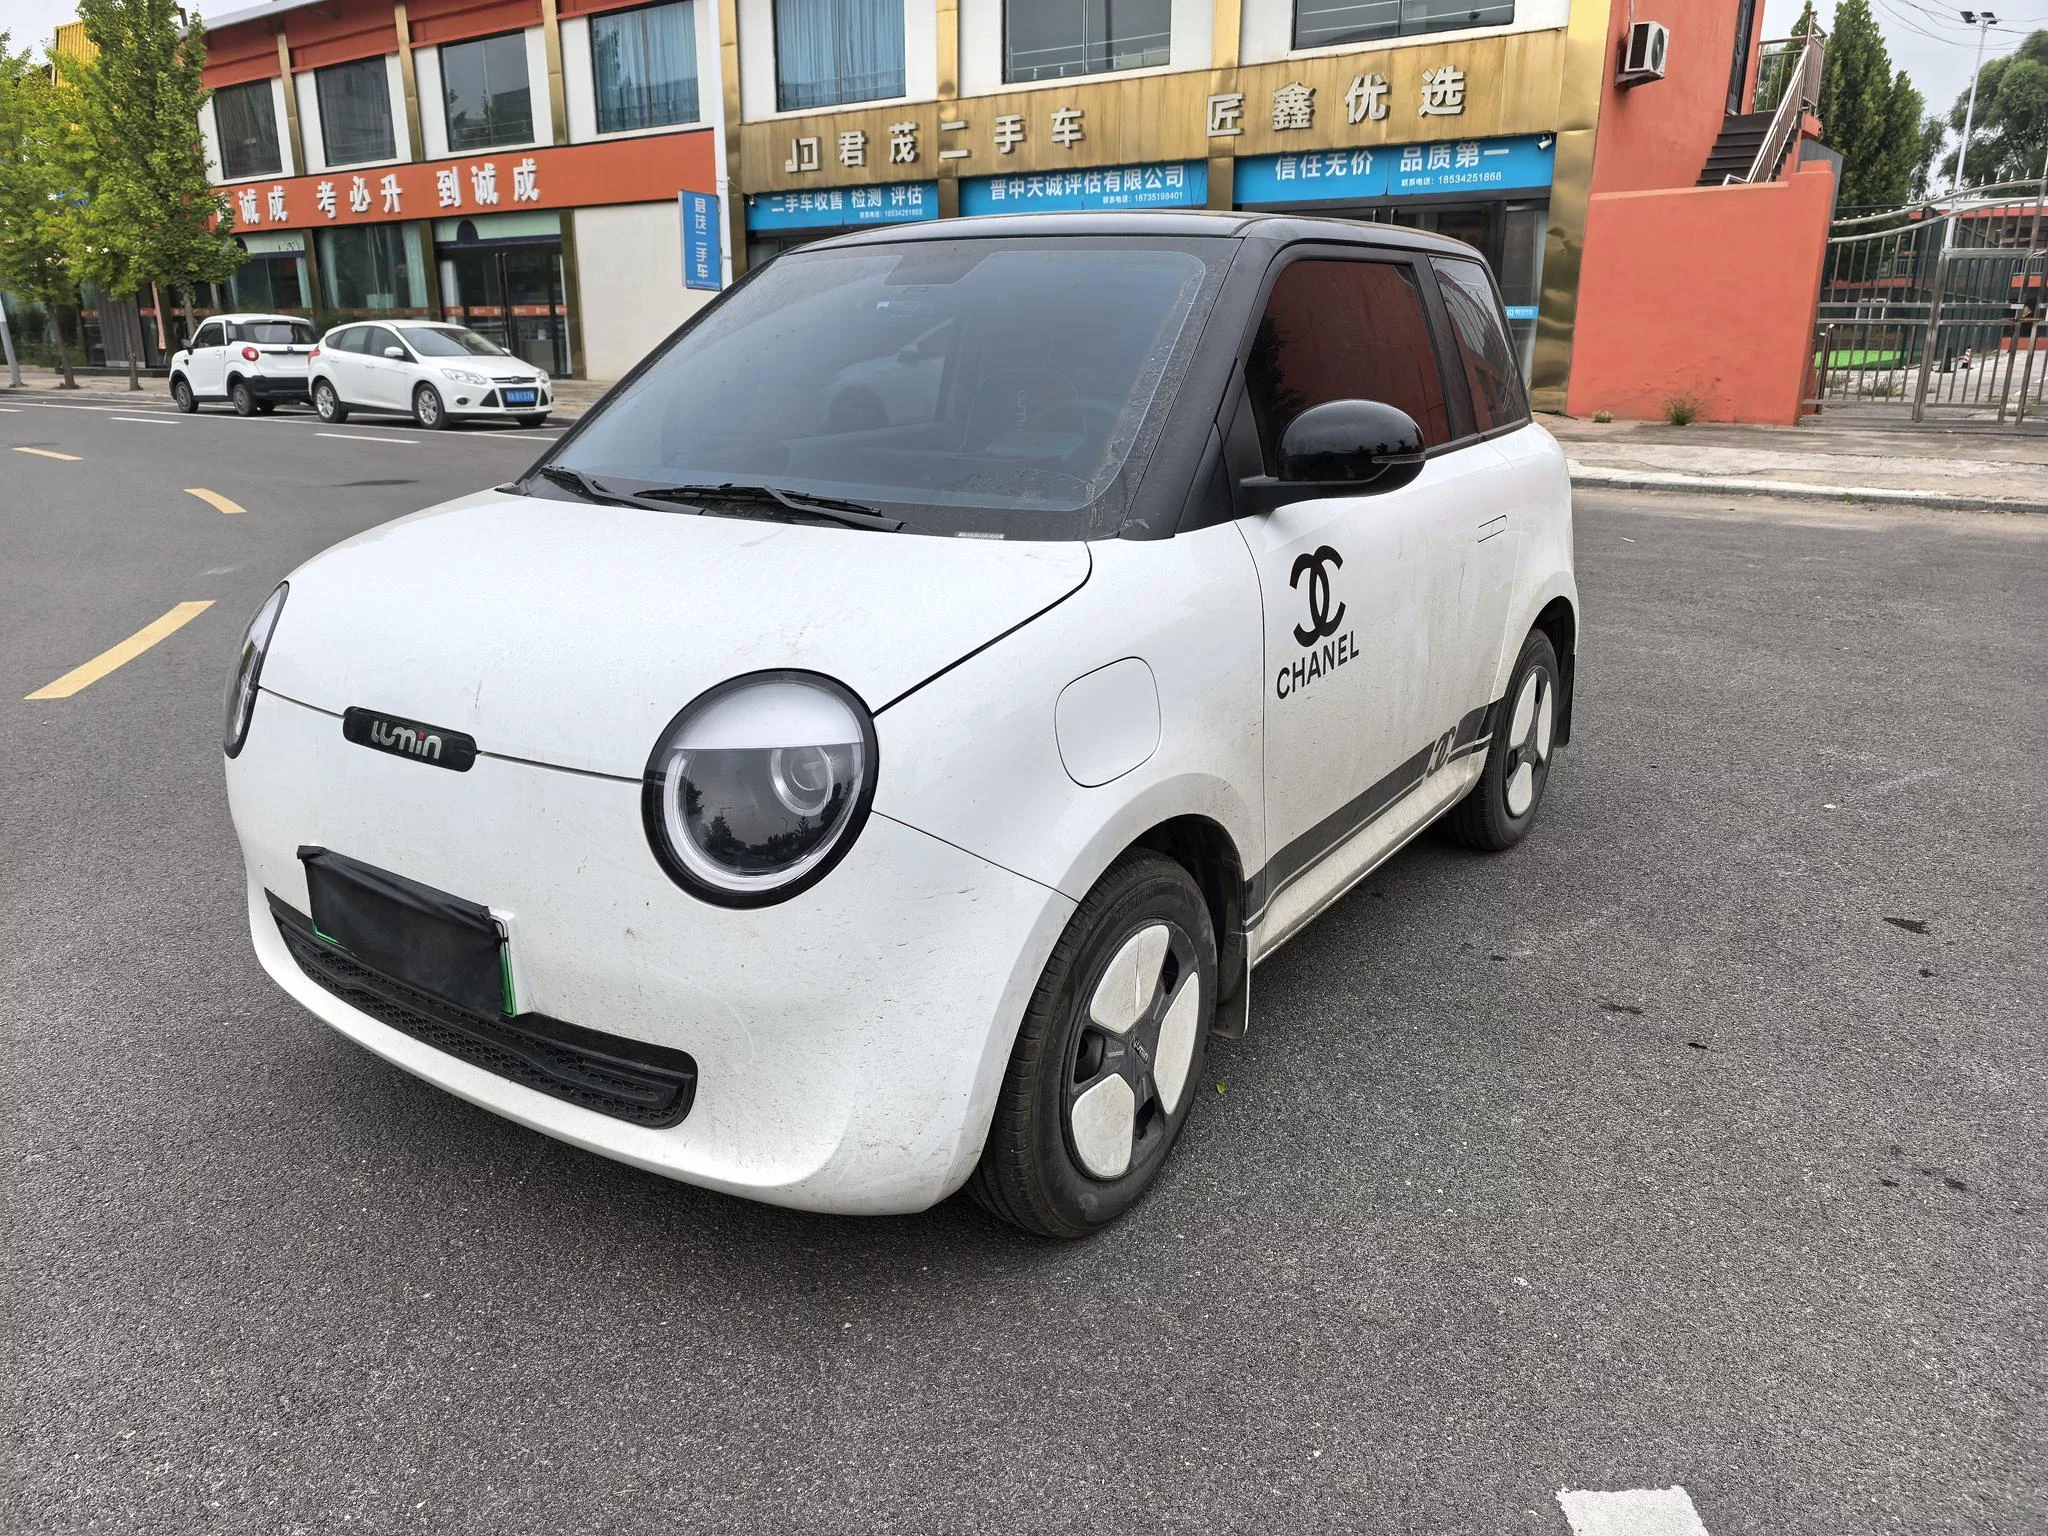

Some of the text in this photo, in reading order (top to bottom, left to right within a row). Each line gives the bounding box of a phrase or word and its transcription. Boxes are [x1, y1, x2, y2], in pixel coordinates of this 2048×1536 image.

[1207, 65, 1465, 138] 匠鑫优选
[838, 107, 1083, 167] 君茂二手车
[1275, 141, 1509, 181] 信任无价 品质第一
[215, 158, 540, 225] 诚成 考必升 到诚成
[771, 184, 923, 213] 二手车收售 检测 评估
[990, 165, 1184, 201] 晋中天诚评估有限公司
[1438, 172, 1502, 184] 18534251868
[1276, 630, 1360, 700] CHANEL
